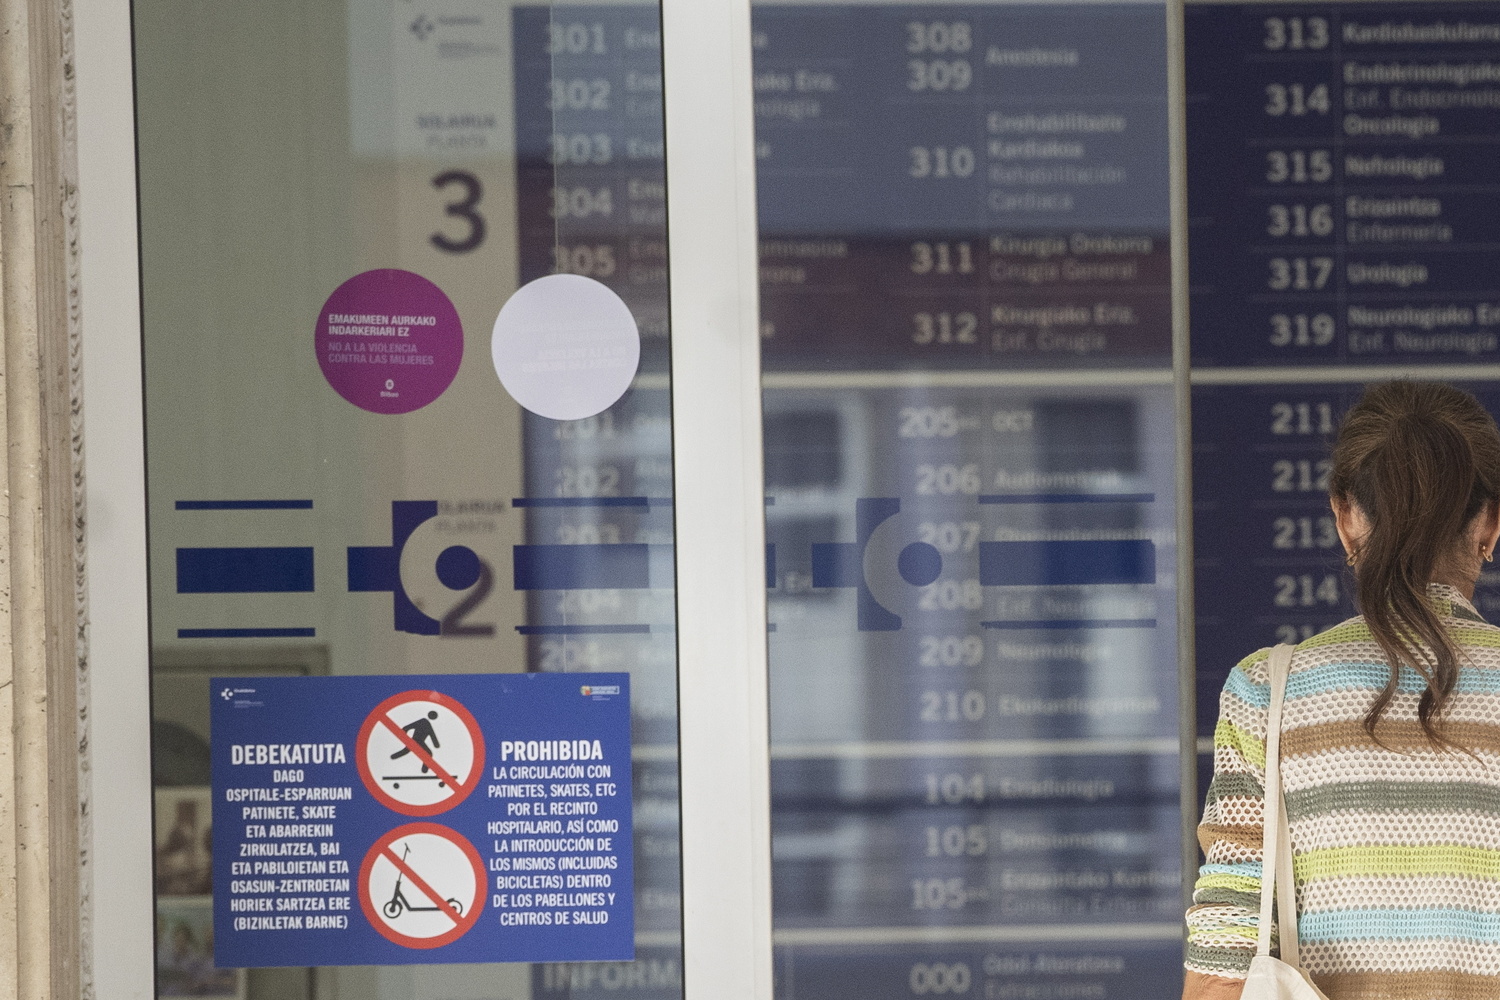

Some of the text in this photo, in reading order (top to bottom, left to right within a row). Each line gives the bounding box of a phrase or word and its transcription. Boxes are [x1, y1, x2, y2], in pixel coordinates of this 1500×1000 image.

[546, 23, 608, 54] 301
[907, 22, 973, 53] 308
[1265, 18, 1328, 48] 313
[907, 60, 973, 91] 309
[547, 78, 611, 110] 302
[1265, 84, 1329, 115] 314
[549, 133, 613, 164] 303
[909, 147, 975, 178] 310
[1266, 151, 1332, 182] 315
[429, 169, 487, 254] 3
[551, 187, 615, 218] 304
[1267, 204, 1333, 236] 316
[911, 243, 974, 274] 311
[1269, 257, 1334, 289] 317
[329, 314, 436, 326] EMAKUMEEN AURKAKO
[329, 326, 409, 336] INDARKERIARI EZ
[912, 312, 978, 344] 312
[1270, 314, 1336, 346] 319
[329, 342, 417, 353] NO A LA VIOLENCIA
[329, 354, 434, 365] CONTRA LAS MUJERES
[1271, 403, 1333, 435] 211
[916, 465, 980, 496] 206
[1273, 518, 1338, 549] 213
[1275, 575, 1339, 606] 214
[918, 638, 984, 667] 209
[920, 692, 986, 722] 210
[231, 744, 346, 765] DEBEKATUTA
[501, 740, 603, 761] PROHIBIDA
[273, 769, 304, 783] DAGO
[494, 763, 611, 780] LA CIRCULACIÓN CON
[226, 788, 352, 801] OSPITALE-ESPARRUAN
[488, 784, 616, 799] PATINETES, SKATES, ETC
[925, 774, 986, 804] 104
[243, 806, 336, 821] PATINETE, SKATE
[508, 802, 597, 816] POR EL RECINTO
[246, 824, 333, 837] ETA ABARREKIN
[488, 817, 618, 835] HOSPITALARIO, ASÍ COMO
[240, 843, 340, 858] ZIRKULATZEA, BAI
[495, 836, 611, 852] LA INTRODUCCIÓN DE
[924, 827, 988, 857] 105
[232, 860, 349, 875] ETA PABILOIETAN ETA
[490, 856, 617, 871] LOS MISMOS (INCLUIDAS
[231, 879, 350, 893] OSASUN-ZENTROETAN
[496, 875, 611, 890] BICICLETAS) DENTRO
[231, 898, 350, 912] HORIEK SARTZEA ERE
[493, 893, 615, 907] DE LOS PABELLONES Y
[234, 916, 348, 931] (BIZIKLETAK BARNE)
[501, 912, 608, 925] CENTROS DE SALUD
[910, 963, 971, 995] 000
